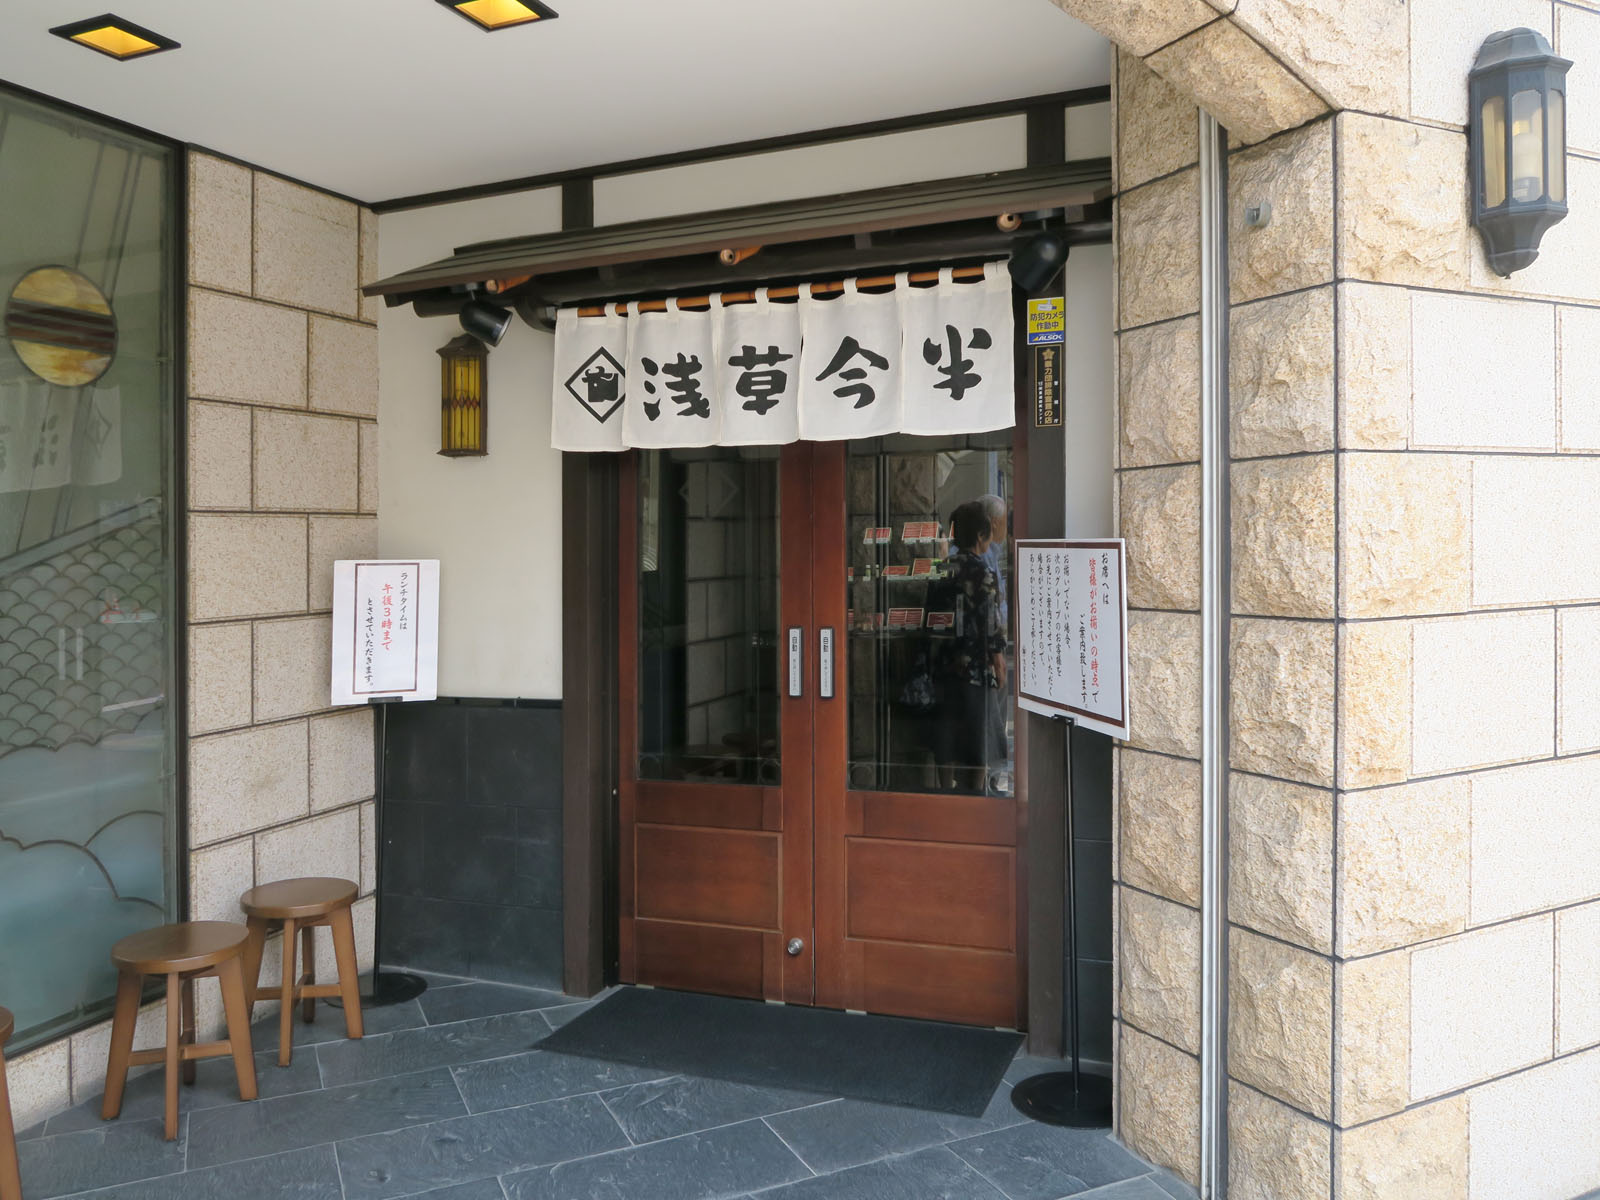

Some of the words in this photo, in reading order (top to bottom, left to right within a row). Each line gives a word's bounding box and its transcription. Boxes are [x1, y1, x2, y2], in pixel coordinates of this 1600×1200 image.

[1031, 312, 1064, 321] 防犯カメラ
[1037, 321, 1058, 330] 作動中
[640, 323, 993, 422] 浅草今半
[400, 573, 408, 630] ランチタイムは
[1101, 553, 1109, 604] お席へは
[365, 598, 373, 686] とさせていただきます。
[381, 583, 394, 651] 午後3時まで
